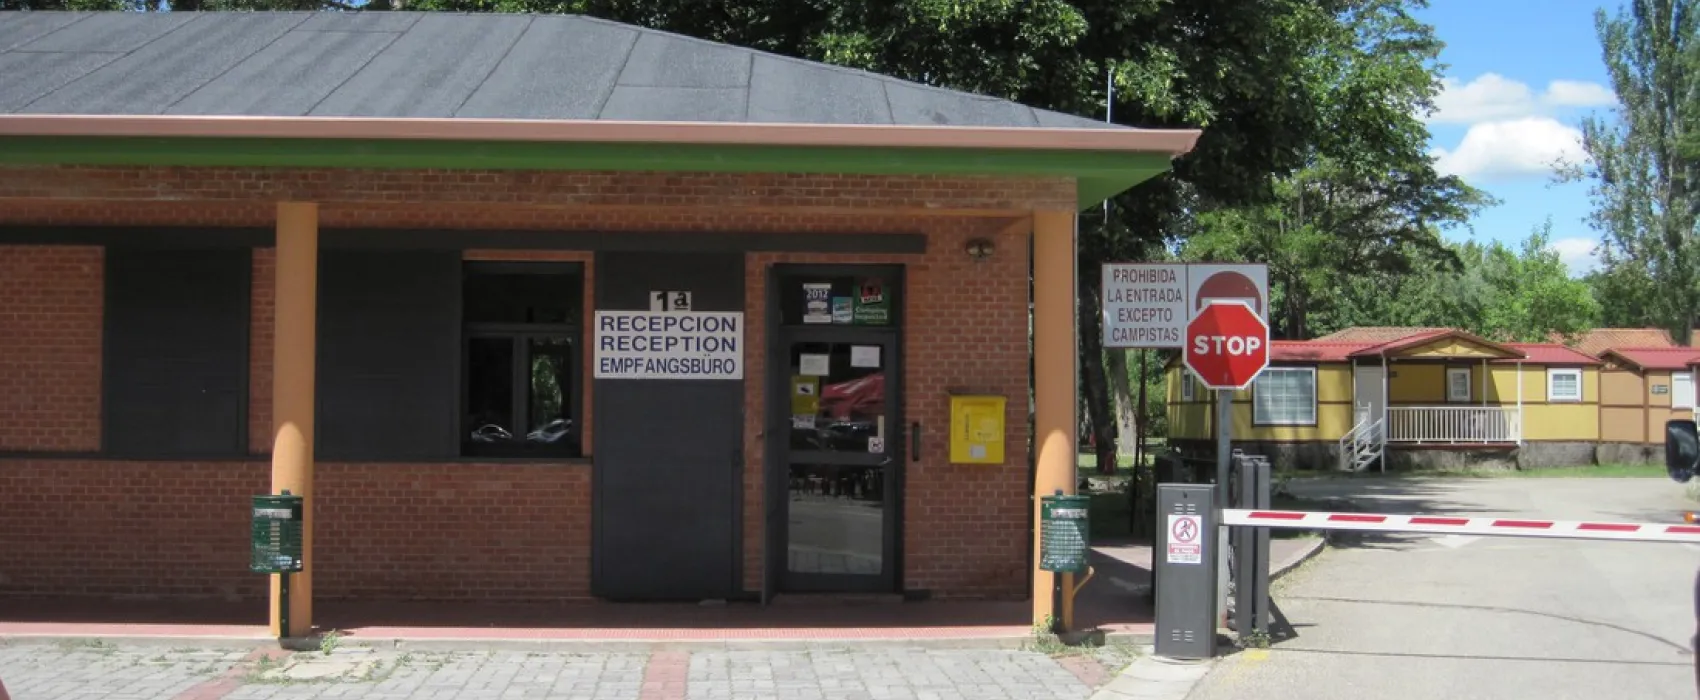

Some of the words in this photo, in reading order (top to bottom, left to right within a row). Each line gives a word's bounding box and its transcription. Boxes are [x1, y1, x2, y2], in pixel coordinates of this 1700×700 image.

[1113, 268, 1176, 284] PROHIBIDA
[806, 289, 829, 300] 2012
[1107, 289, 1123, 303] LA
[1126, 289, 1183, 303] ENTRADA
[600, 315, 737, 332] RECEPCION
[1118, 308, 1173, 323] EXCEPTO
[1112, 327, 1179, 342] CAMPISTAS
[600, 335, 737, 352] RECEPTION
[1194, 336, 1261, 356] STOP
[600, 353, 736, 374] EMPFANGSBÜRO
